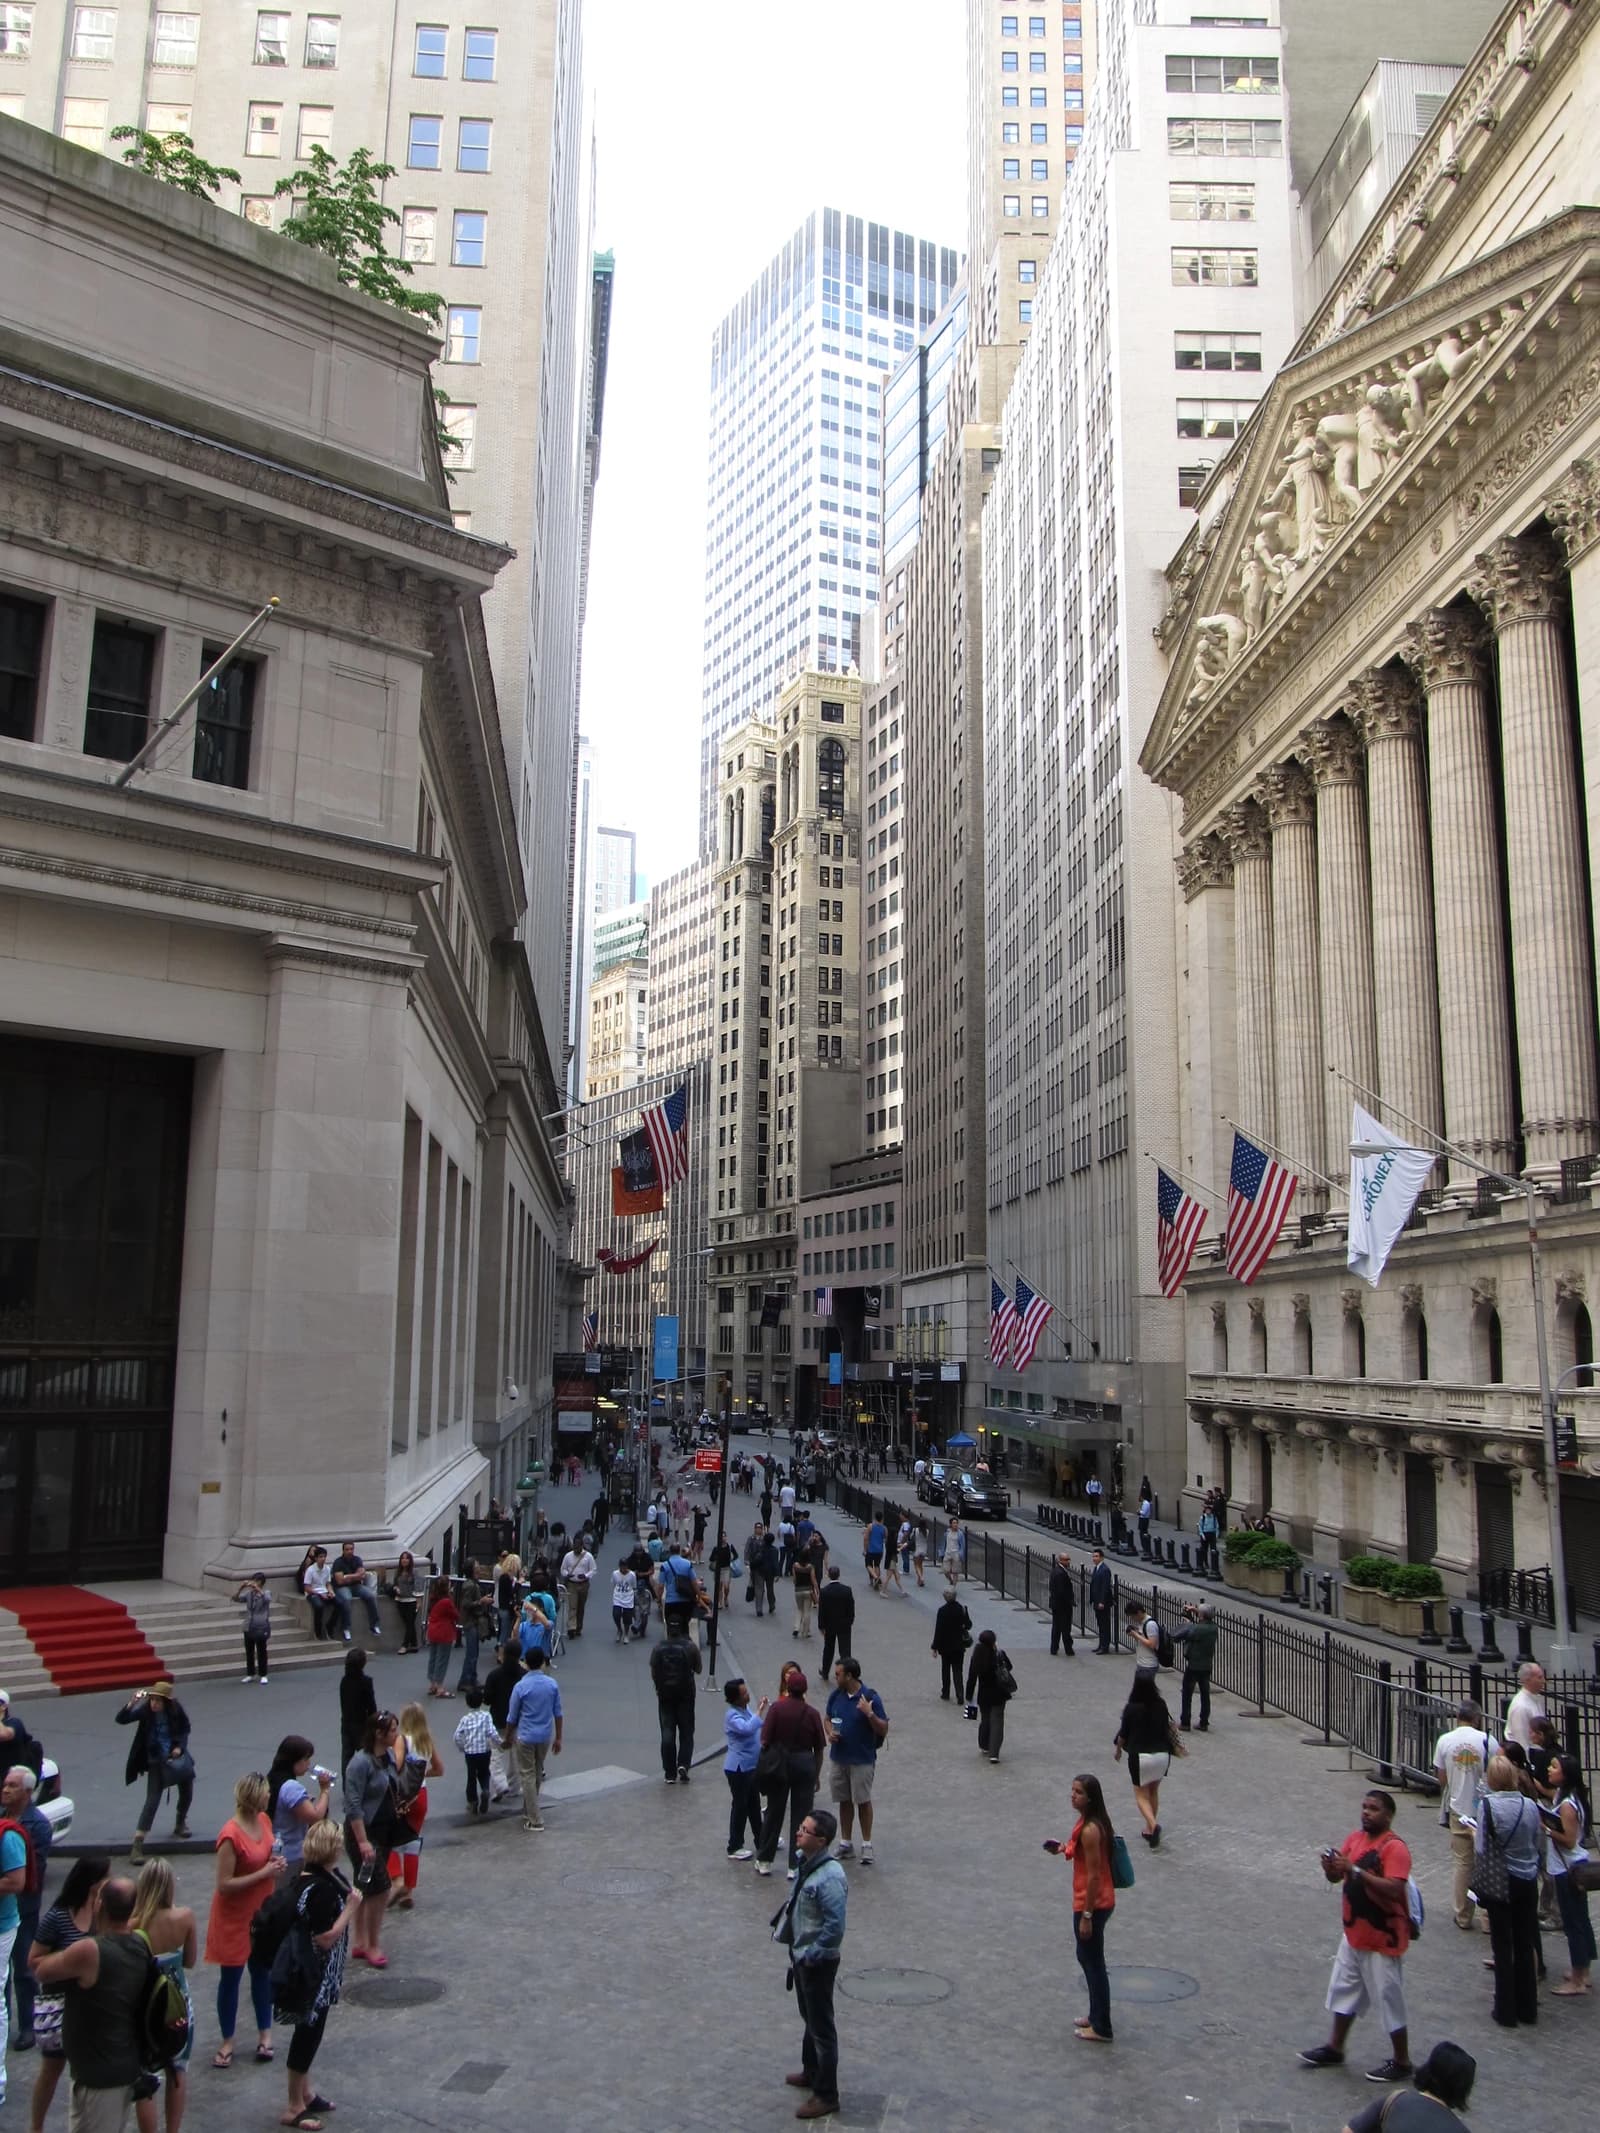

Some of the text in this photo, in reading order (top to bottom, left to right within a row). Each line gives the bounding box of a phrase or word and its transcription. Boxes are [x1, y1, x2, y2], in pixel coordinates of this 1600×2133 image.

[1286, 667, 1312, 709] YORK
[1318, 627, 1351, 676] STOCK
[1356, 551, 1422, 637] EXCHANGE
